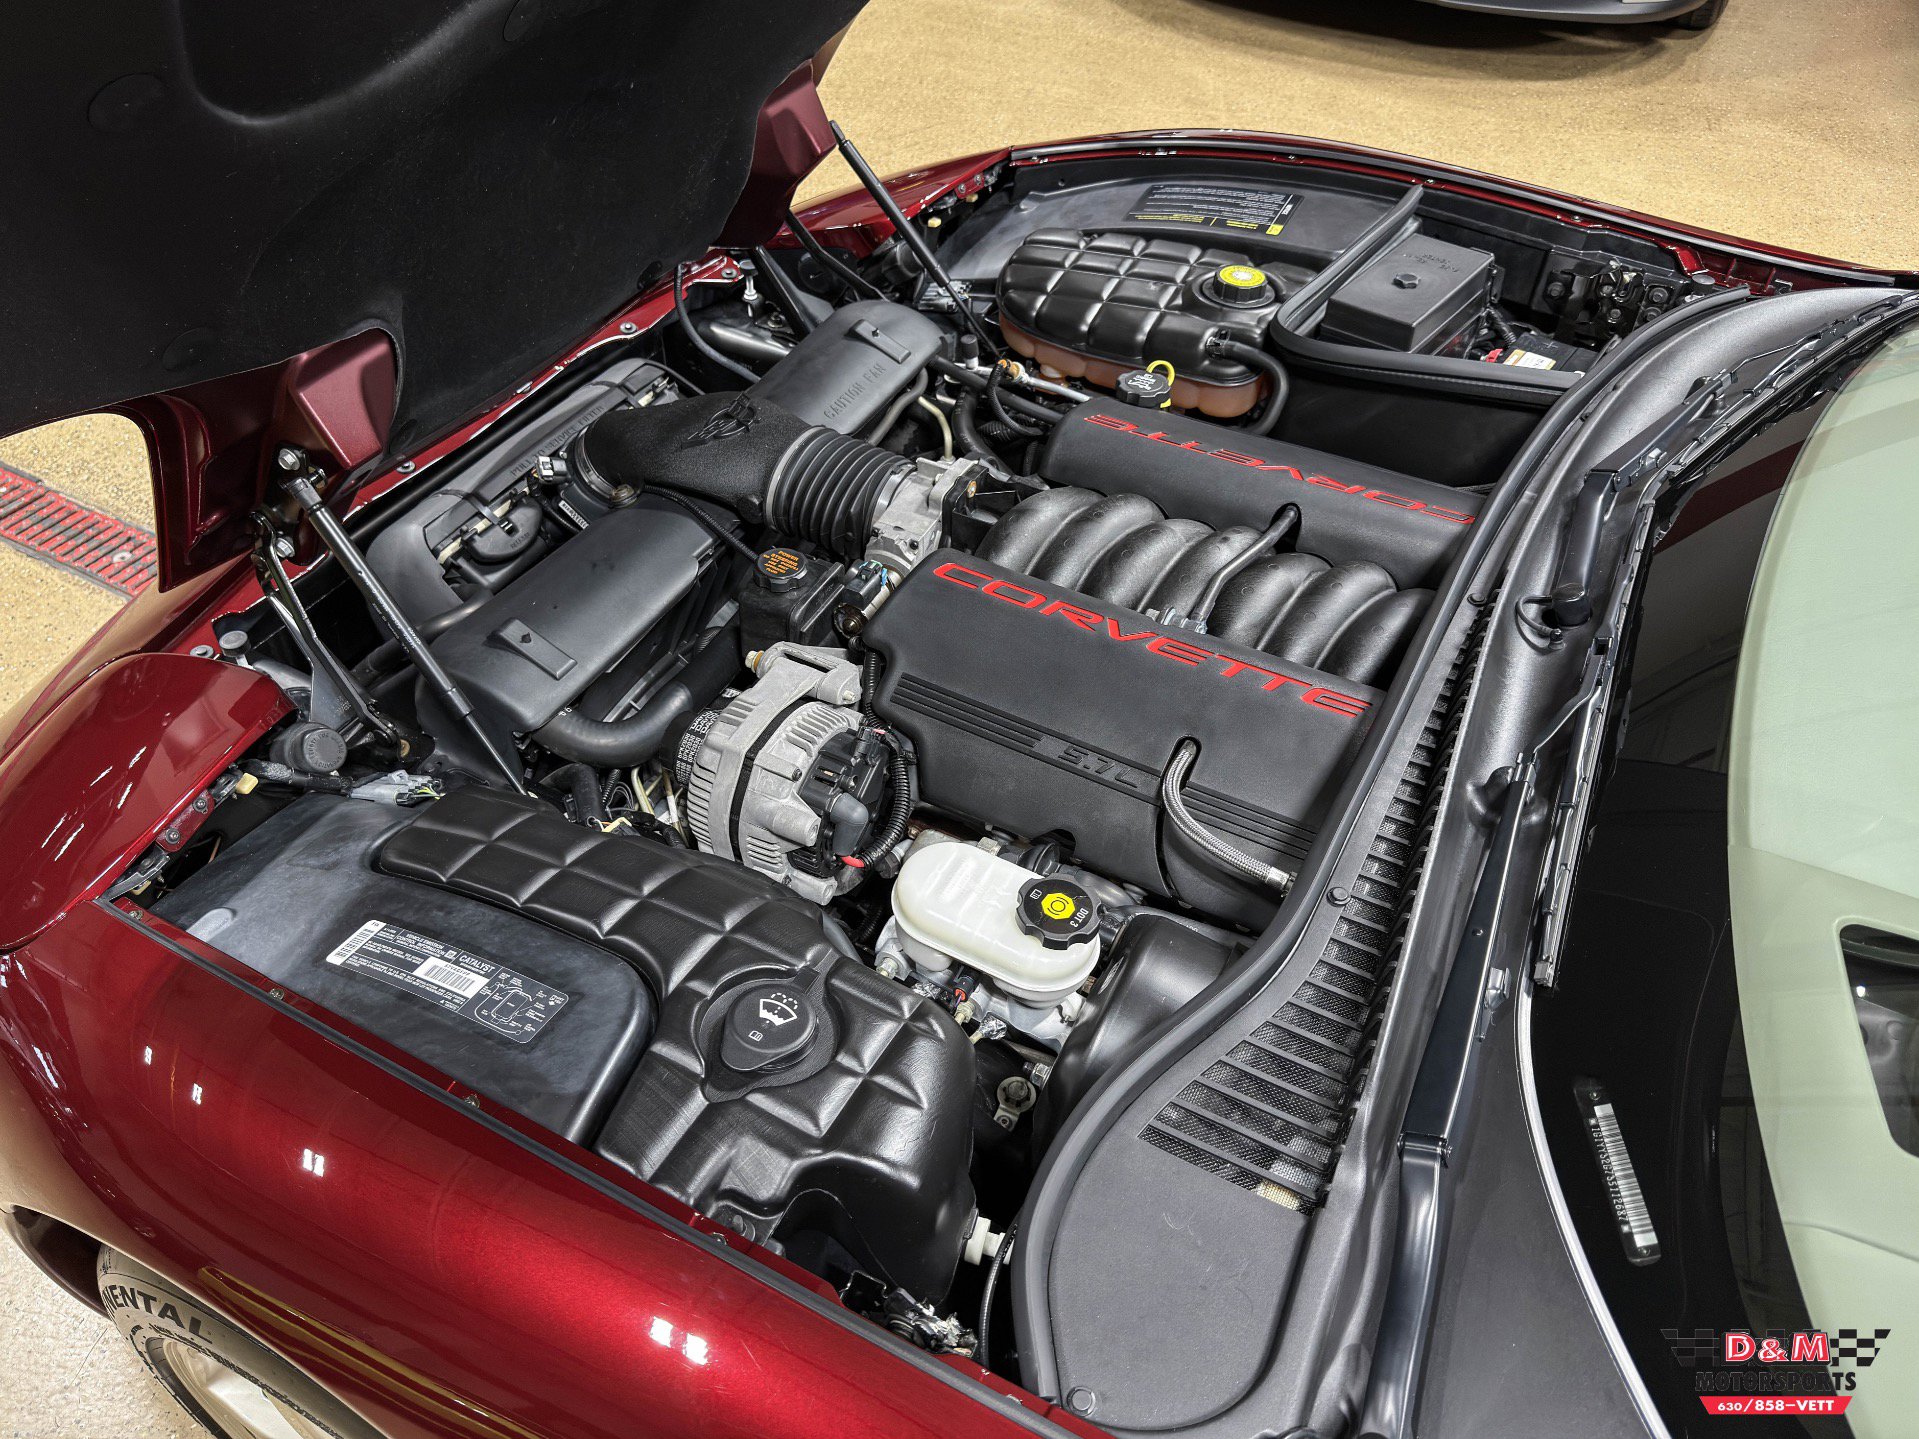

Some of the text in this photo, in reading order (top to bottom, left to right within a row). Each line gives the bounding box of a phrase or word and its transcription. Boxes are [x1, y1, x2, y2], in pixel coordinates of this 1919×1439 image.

[823, 363, 886, 419] CAUTION FAN
[1084, 414, 1475, 525] CORVETTE
[933, 562, 1373, 718] CORVETTE
[1057, 744, 1138, 789] 5.7L
[1076, 907, 1089, 922] DOT
[459, 955, 496, 973] CATALYST
